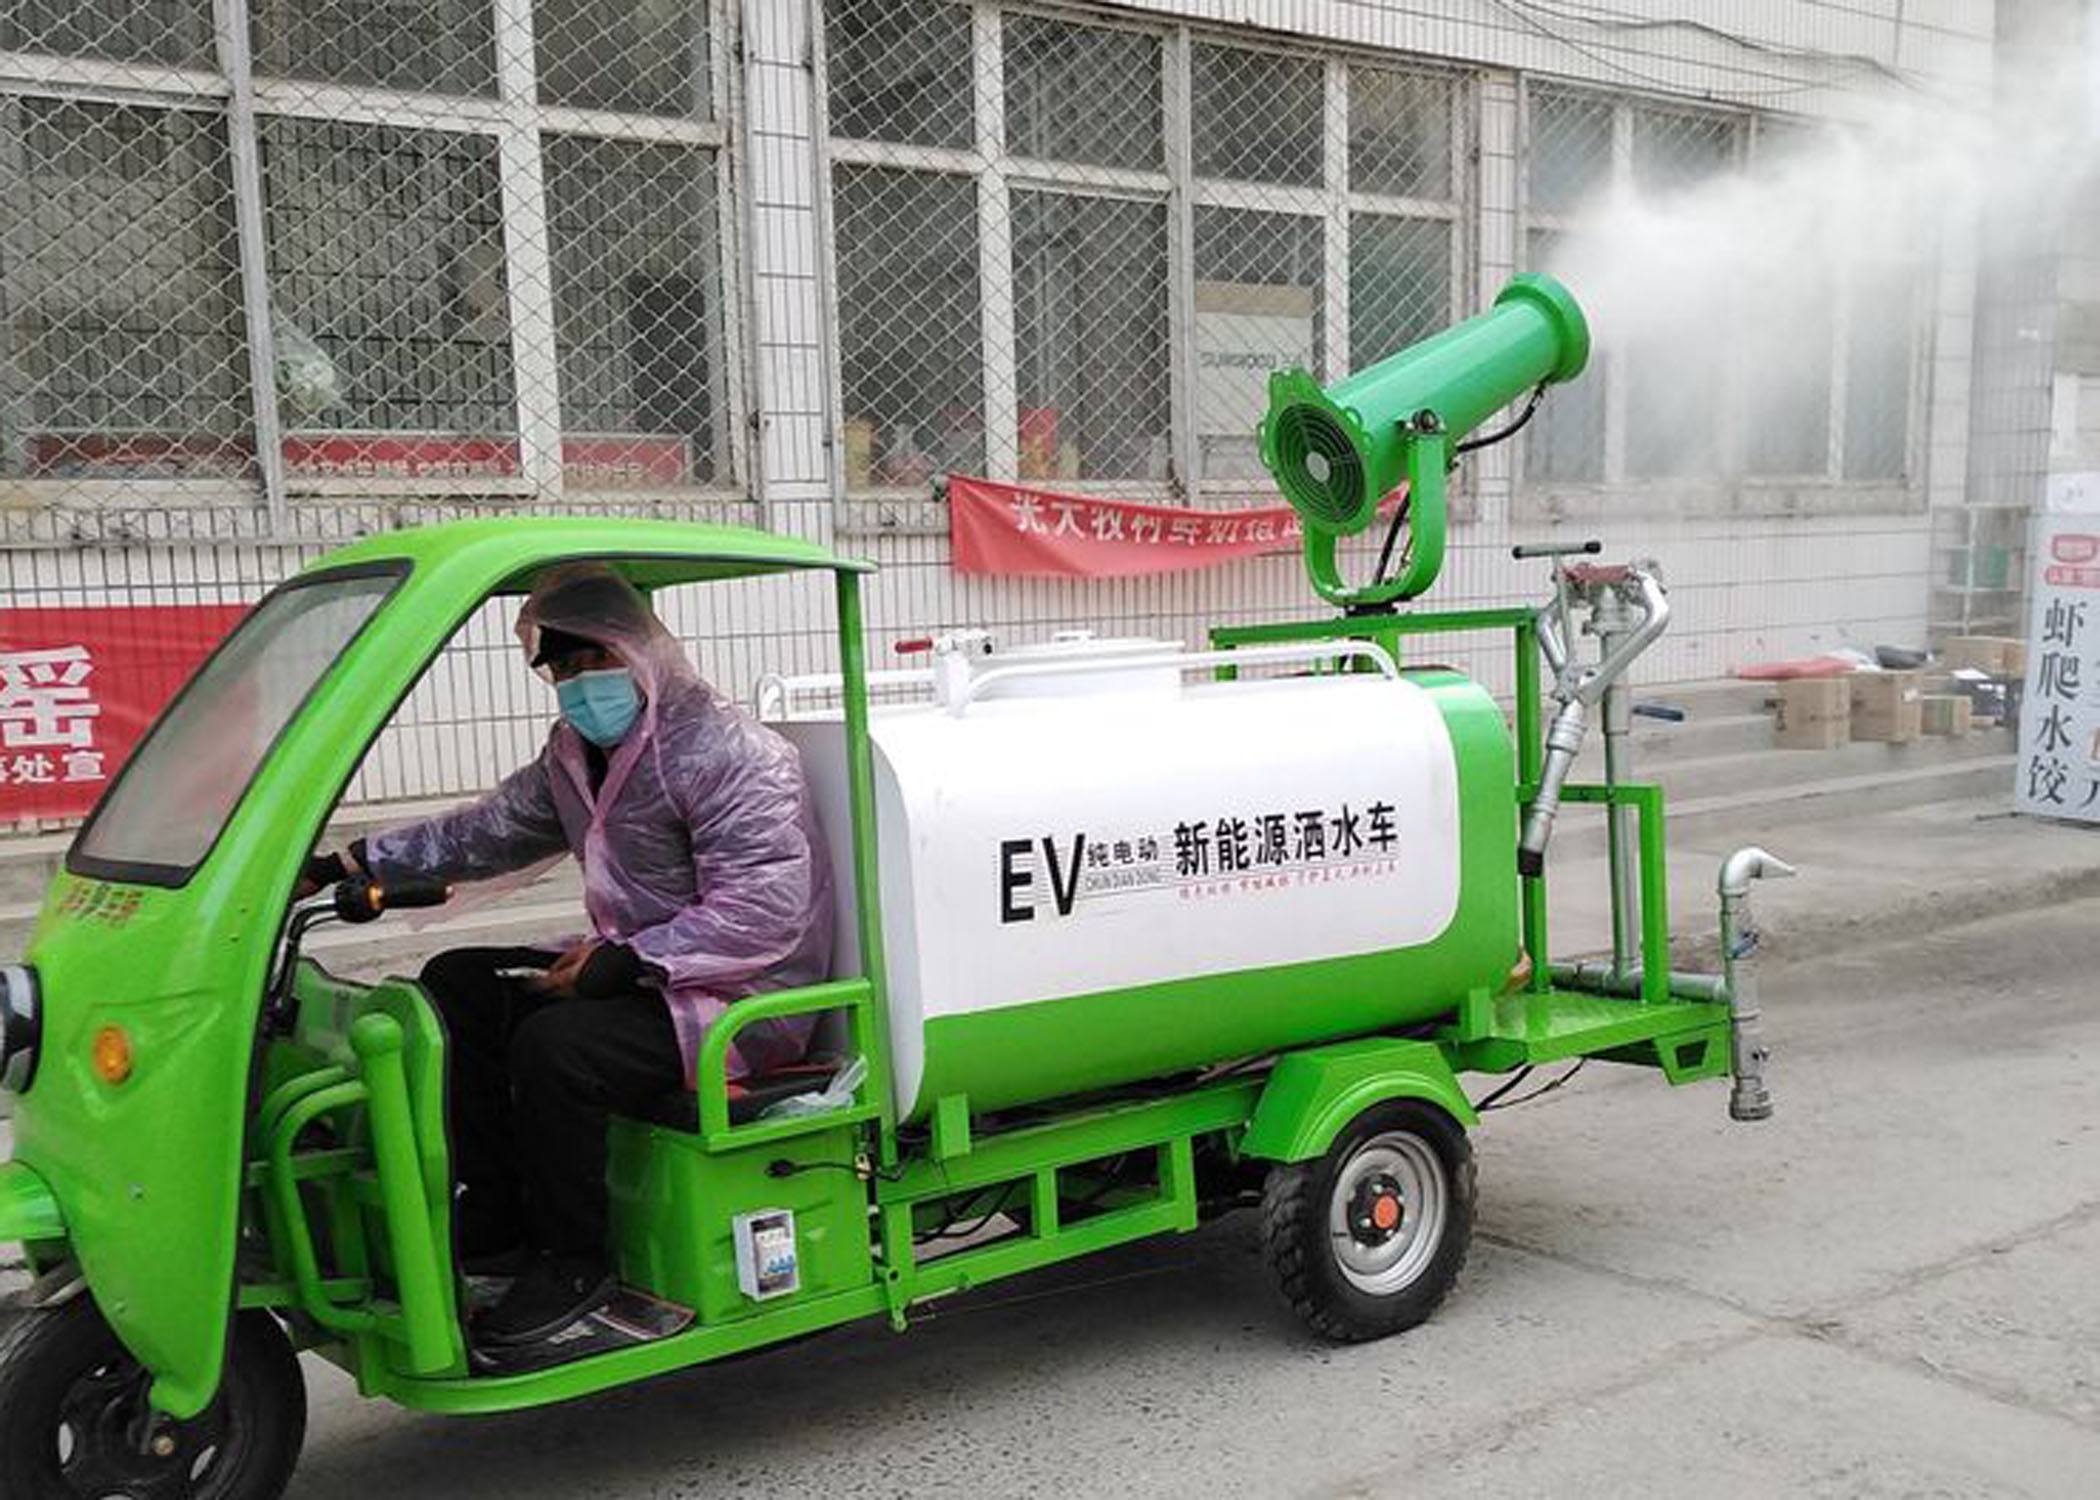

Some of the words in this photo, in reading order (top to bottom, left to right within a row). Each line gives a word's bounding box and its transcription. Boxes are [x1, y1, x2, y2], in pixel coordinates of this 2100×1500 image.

[2027, 598, 2088, 806] 虾爬水饺
[1001, 833, 1086, 923] EV
[1087, 836, 1159, 868] 纯电动
[1174, 801, 1398, 876] 新能源洒水车
